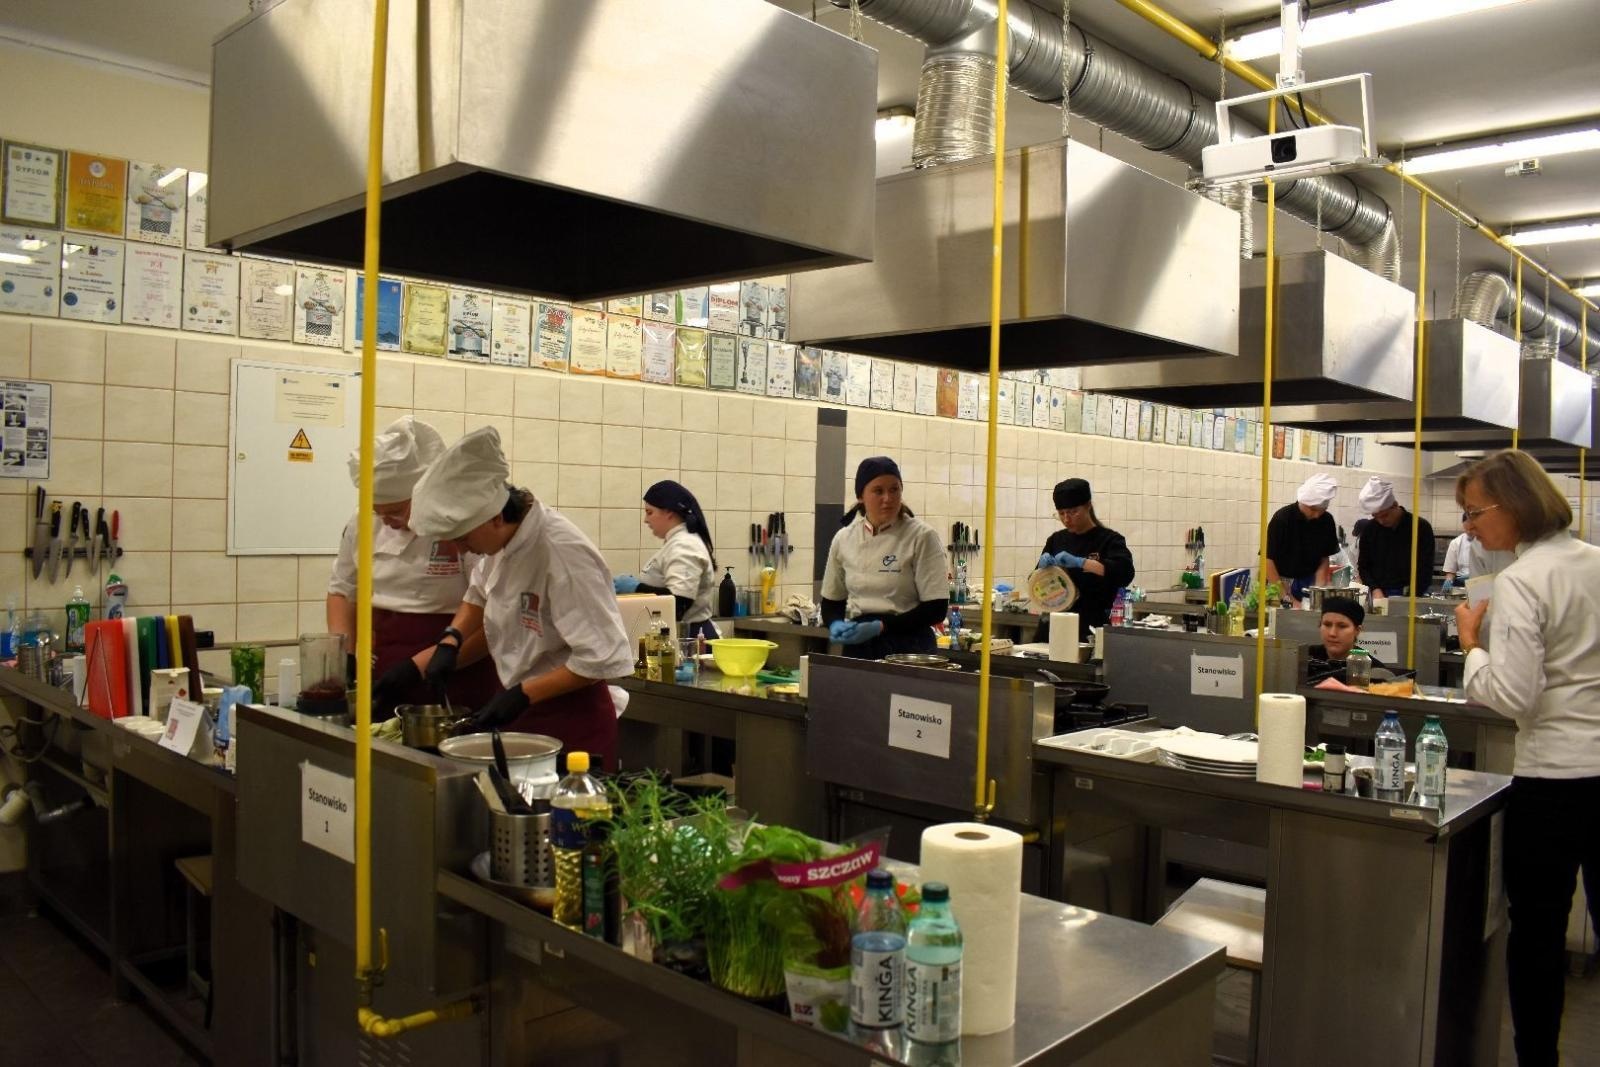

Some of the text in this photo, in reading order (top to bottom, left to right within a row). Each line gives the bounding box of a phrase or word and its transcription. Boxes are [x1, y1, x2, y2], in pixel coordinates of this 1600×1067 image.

[710, 296, 738, 306] DIPLOM
[1197, 666, 1237, 676] Stanowisko
[898, 708, 942, 725] Stanowisko
[916, 729, 922, 739] 2
[1391, 752, 1400, 788] KINGA
[308, 787, 348, 813] Stanowisko
[324, 820, 329, 833] 1
[878, 956, 893, 1023] KINGA
[905, 967, 917, 1034] KINGA
